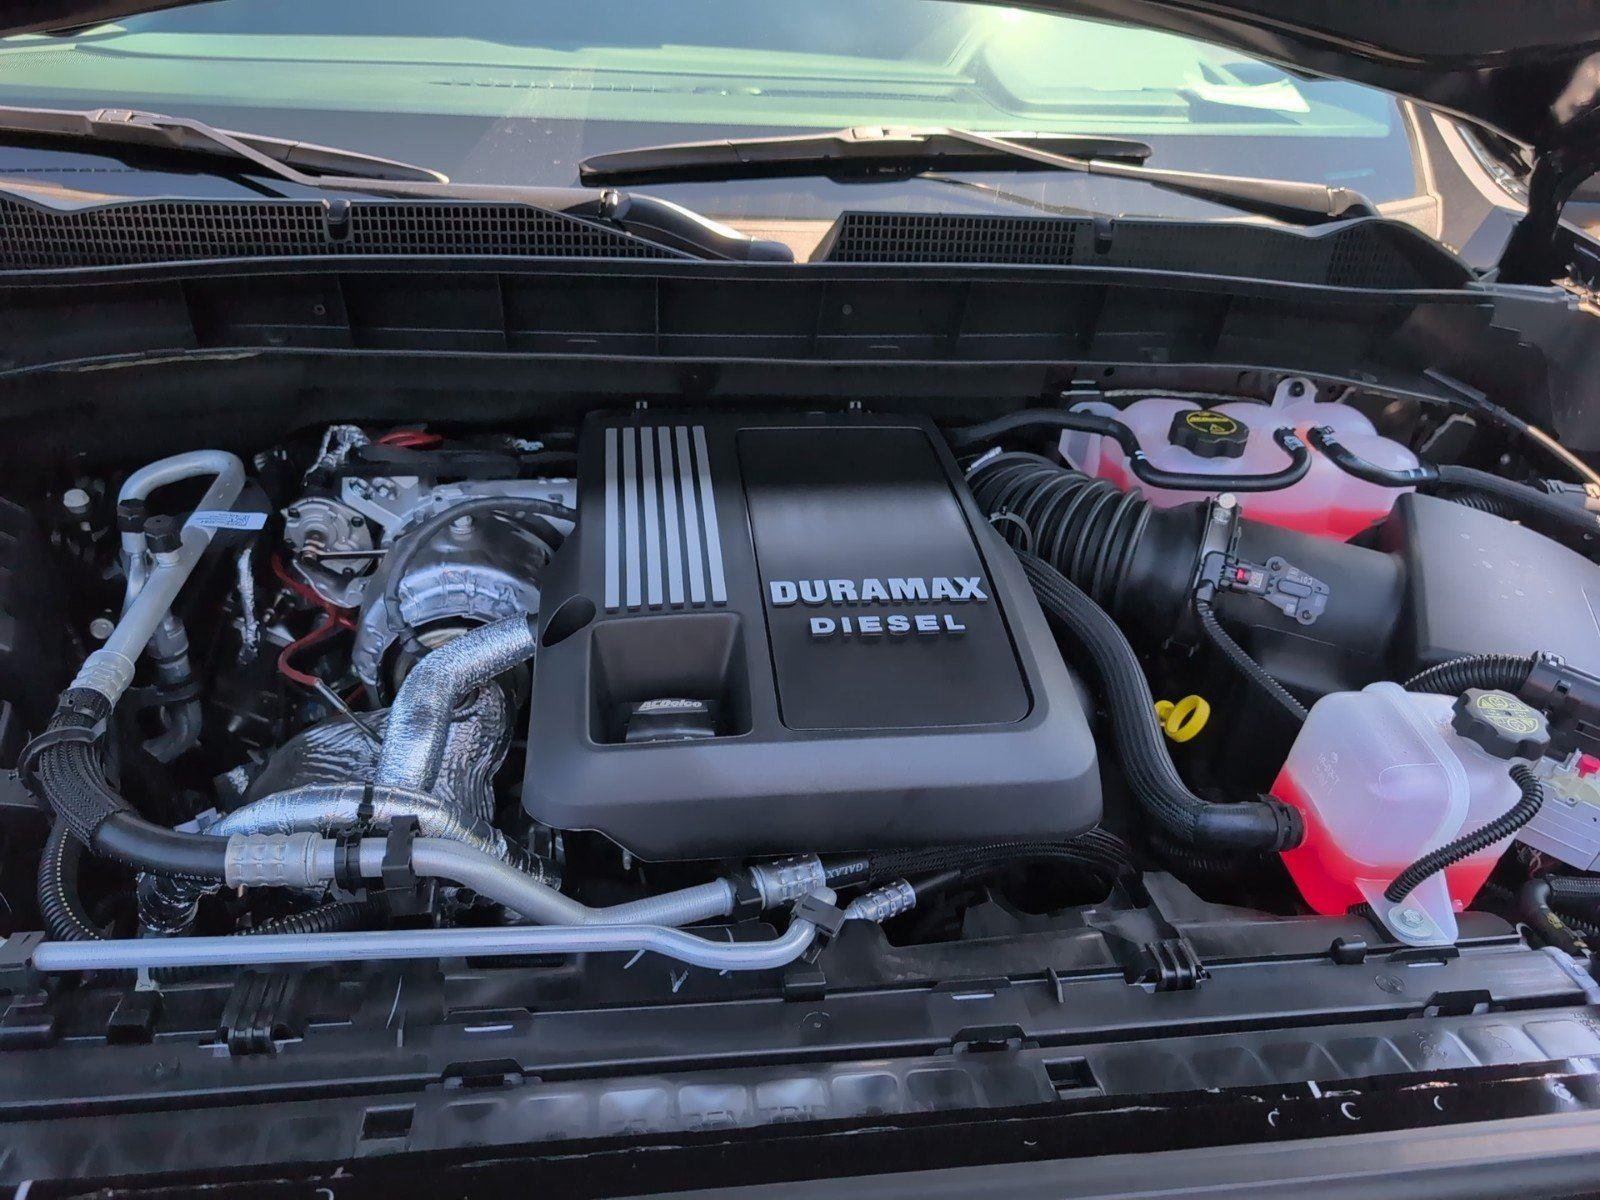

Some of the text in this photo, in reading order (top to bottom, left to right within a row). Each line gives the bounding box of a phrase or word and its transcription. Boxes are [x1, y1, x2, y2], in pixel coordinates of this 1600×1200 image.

[769, 577, 988, 604] DURAMAX
[810, 614, 966, 635] DIESEL
[639, 699, 702, 711] ACDelco
